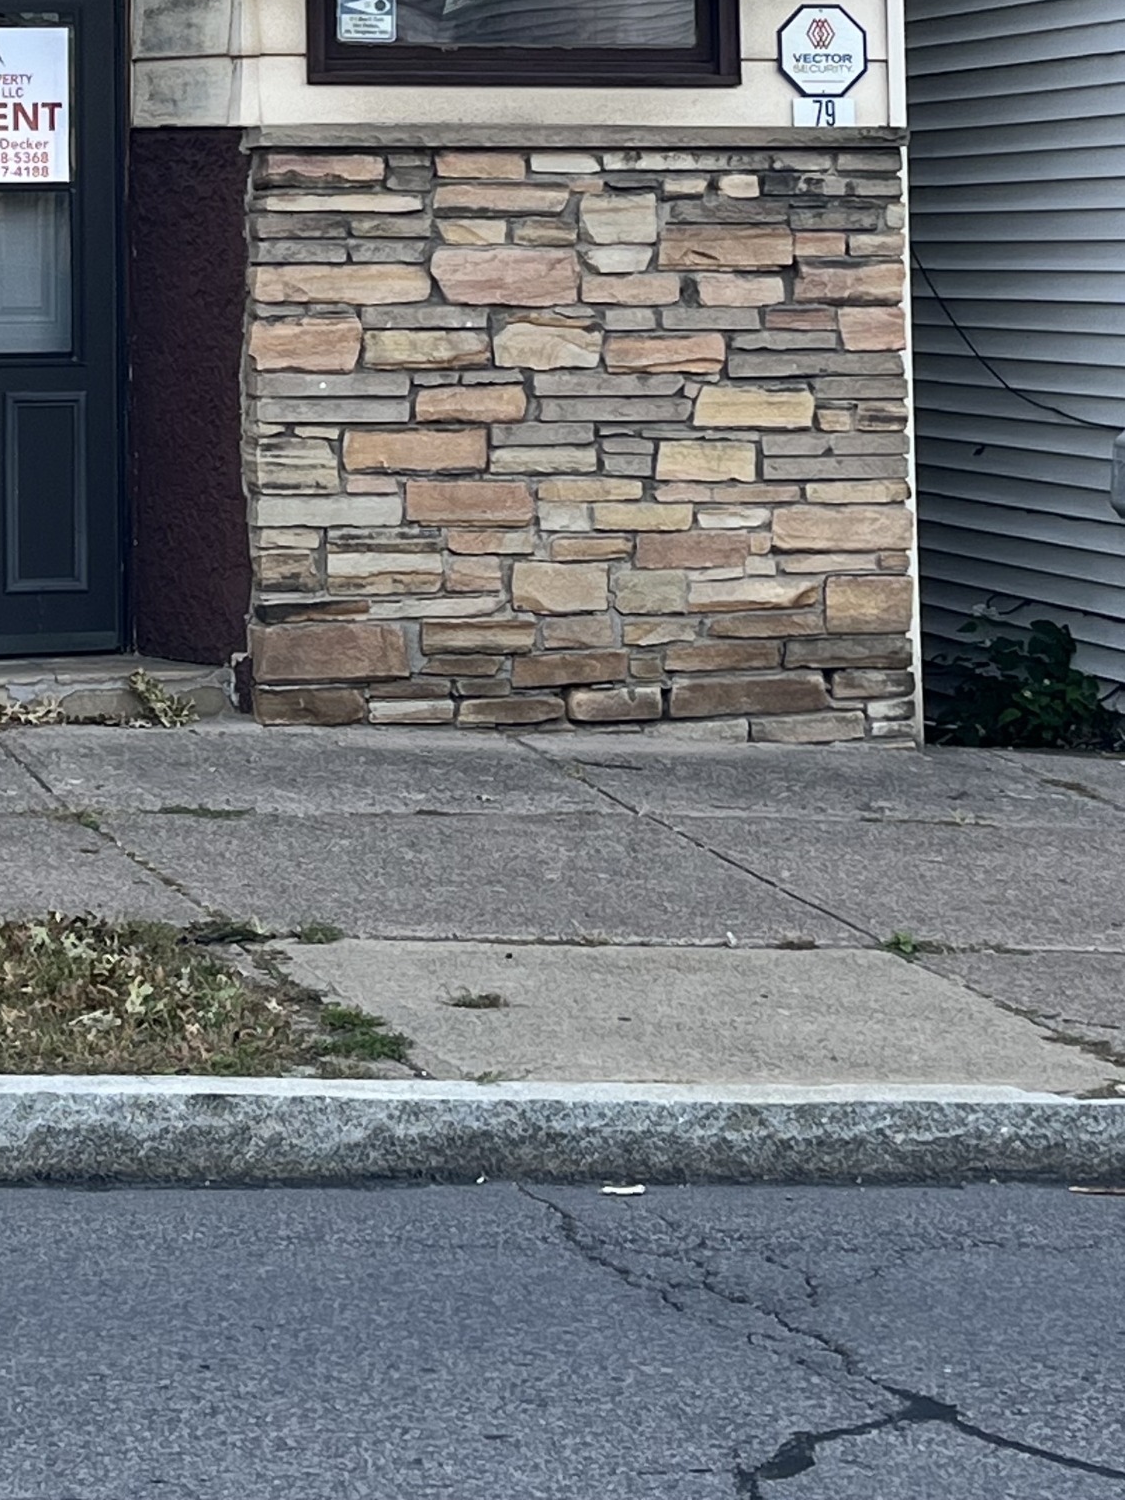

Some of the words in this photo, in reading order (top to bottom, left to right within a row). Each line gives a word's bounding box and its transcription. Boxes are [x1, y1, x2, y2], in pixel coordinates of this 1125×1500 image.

[792, 53, 853, 64] VECTOR
[1, 87, 25, 98] LLC
[812, 99, 836, 127] 79
